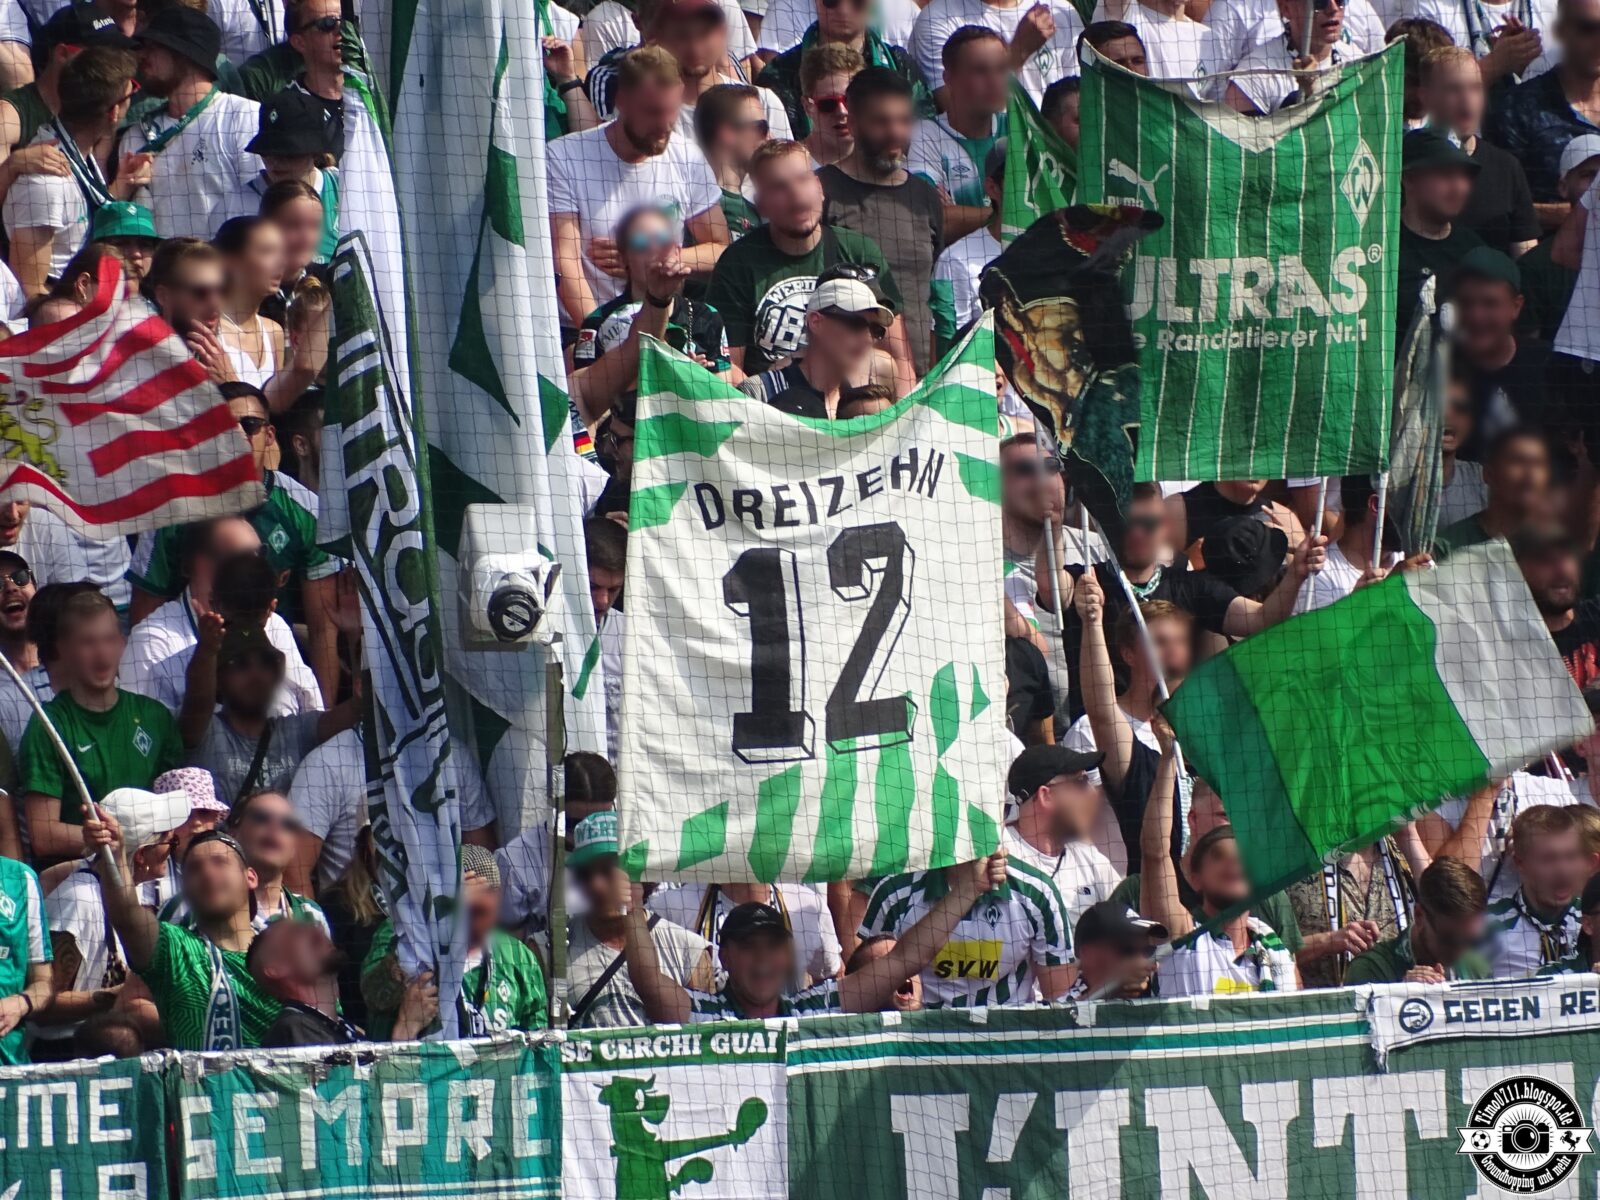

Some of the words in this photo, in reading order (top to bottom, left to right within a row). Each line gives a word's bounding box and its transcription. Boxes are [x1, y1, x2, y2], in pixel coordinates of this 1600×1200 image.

[767, 279, 818, 305] WERD
[759, 304, 808, 352] 18
[1156, 325, 1318, 351] Randalierer
[1326, 318, 1367, 345] Nr.1
[694, 447, 944, 531] DREIZEHN
[722, 521, 918, 764] 12
[934, 960, 999, 979] SVW
[1443, 996, 1541, 1024] GEGEN
[1560, 988, 1600, 1017] RE
[560, 1040, 592, 1062] SE
[600, 1033, 702, 1061] CERCHI
[710, 1031, 779, 1053] GUAI
[0, 1077, 133, 1149] ME
[180, 1072, 553, 1180] SEMPRE
